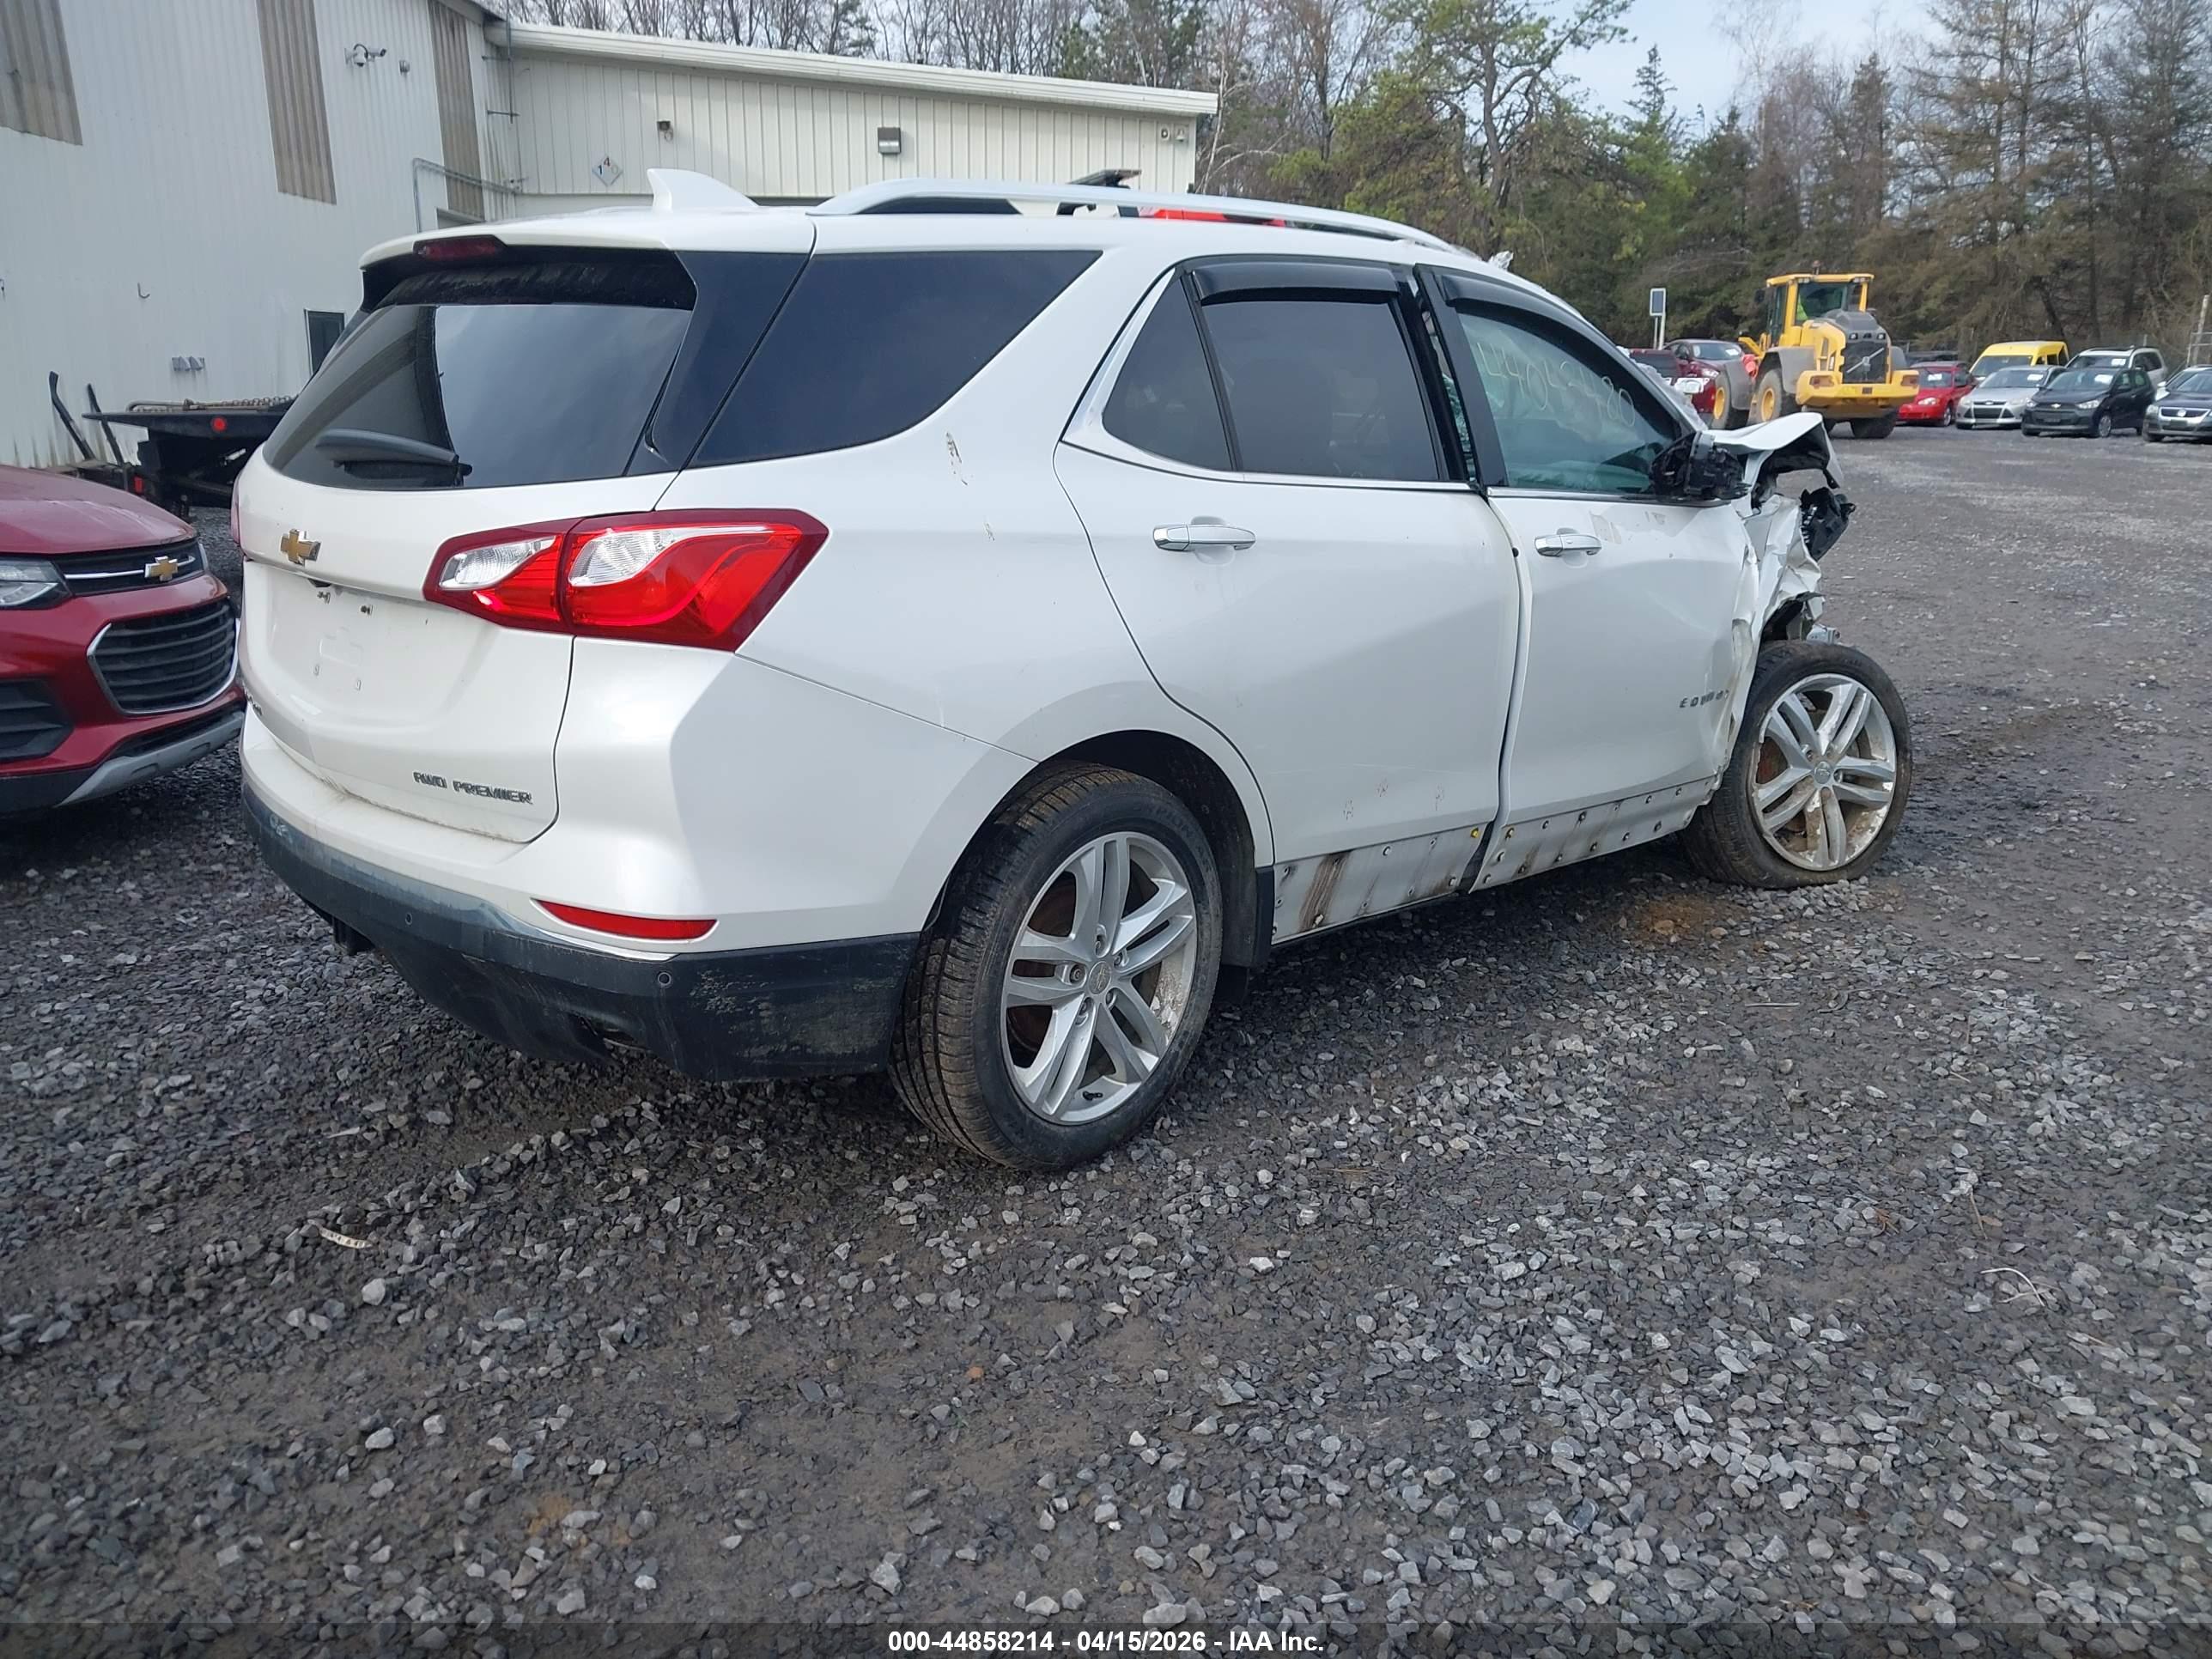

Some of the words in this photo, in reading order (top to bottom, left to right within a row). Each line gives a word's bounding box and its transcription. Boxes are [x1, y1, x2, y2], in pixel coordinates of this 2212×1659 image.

[604, 157, 611, 167] 4
[413, 771, 447, 788] AWD
[453, 781, 532, 805] PREMIER
